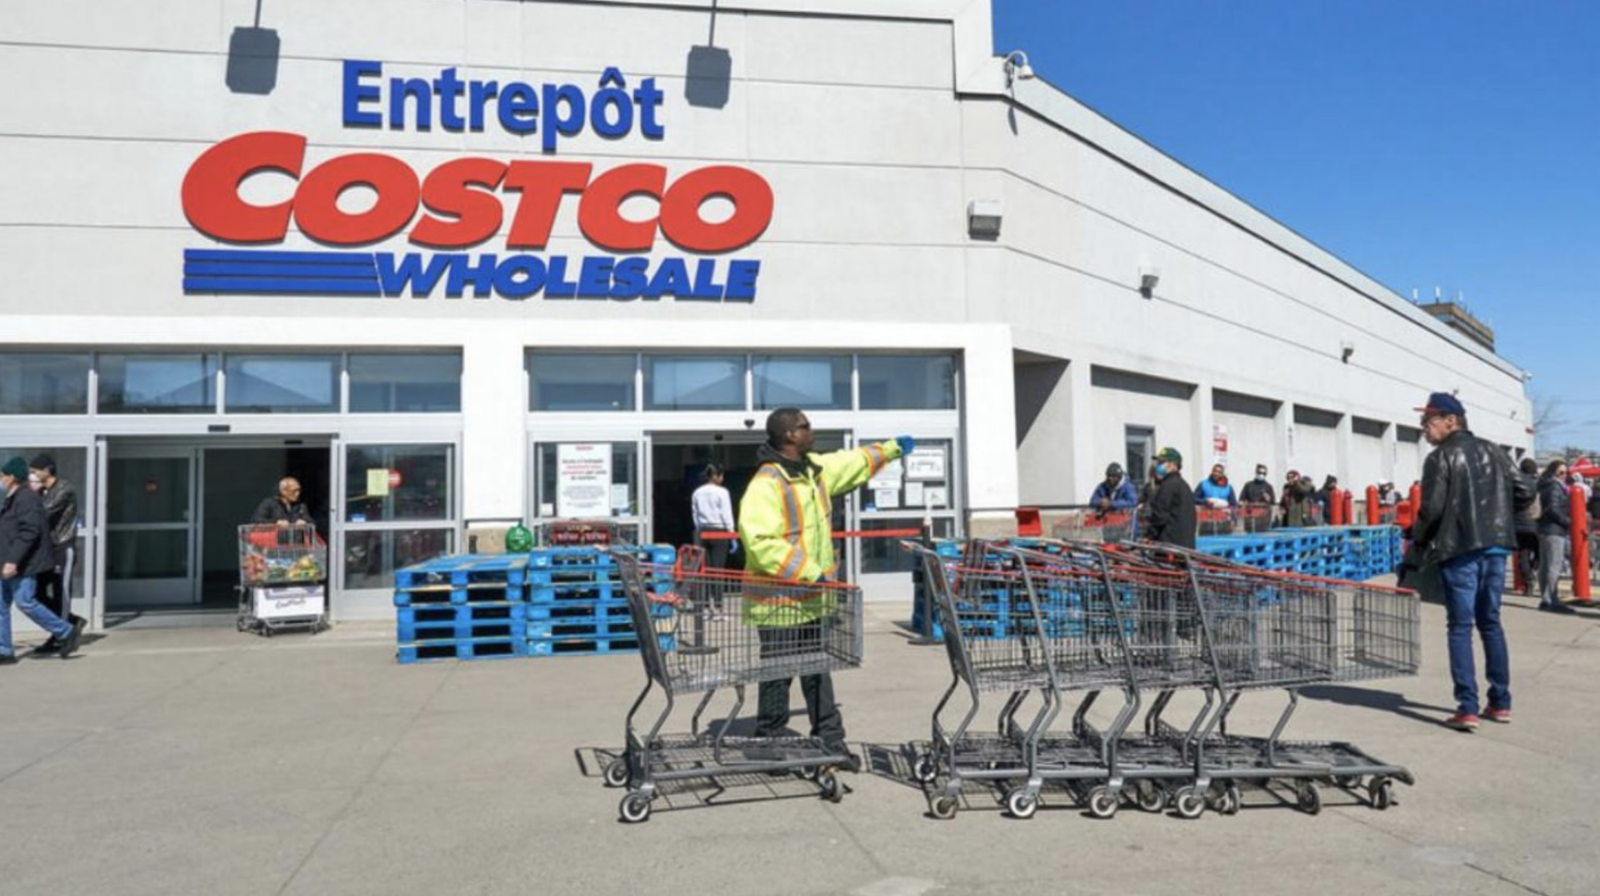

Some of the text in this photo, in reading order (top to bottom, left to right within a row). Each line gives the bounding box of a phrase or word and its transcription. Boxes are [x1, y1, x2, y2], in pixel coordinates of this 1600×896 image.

[343, 59, 663, 153] Entrepôt
[181, 131, 773, 254] COSTCO
[376, 252, 760, 302] WHOLESALE
